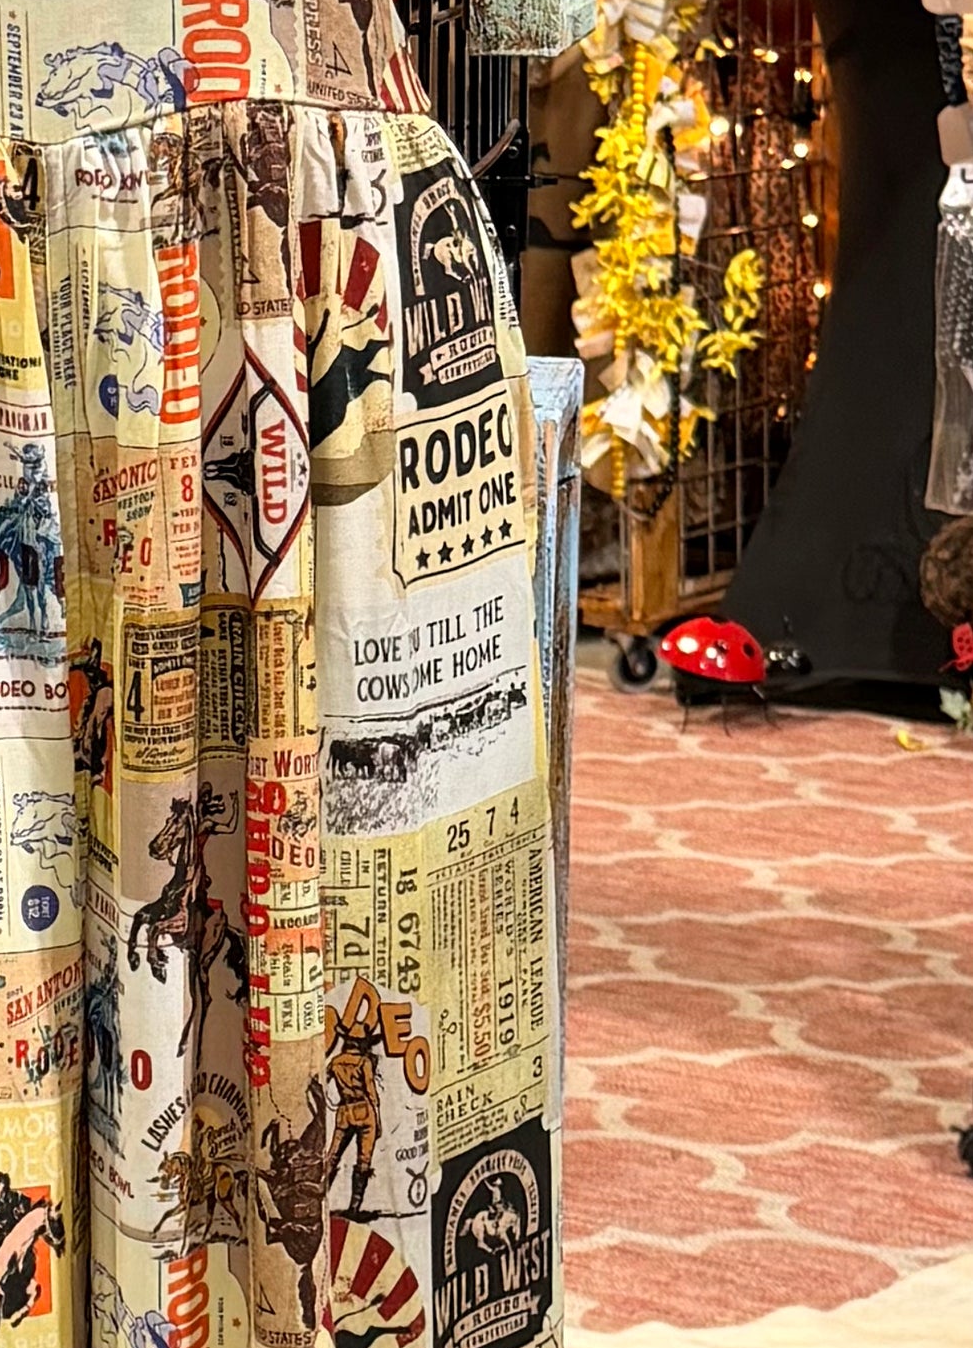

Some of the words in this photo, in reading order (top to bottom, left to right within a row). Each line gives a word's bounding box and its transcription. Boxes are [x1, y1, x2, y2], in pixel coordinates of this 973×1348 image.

[7, 23, 23, 100] SEPTEMBER
[9, 101, 23, 120] 23
[154, 243, 202, 425] RODEO
[403, 292, 465, 356] WILD
[260, 419, 287, 525] WILD
[400, 402, 513, 494] RODEO
[180, 473, 193, 502] 8
[408, 484, 474, 539] ADMIT
[478, 470, 516, 515] ONE
[354, 635, 402, 666] LOVE
[427, 614, 466, 648] TILL
[473, 595, 504, 631] THE
[452, 633, 502, 679] HOME
[127, 671, 145, 723] 4
[447, 820, 470, 852] 25
[486, 806, 497, 836] 7
[510, 796, 519, 824] 4
[528, 848, 544, 944] AMERICAN
[396, 911, 422, 996] 6743
[6, 998, 33, 1026] SAN
[498, 976, 516, 1047] 1919
[530, 954, 545, 1033] LEAGUE
[141, 1096, 186, 1152] LASHES
[435, 1084, 476, 1113] RAIN
[435, 1091, 494, 1128] CHECK
[434, 1263, 490, 1339] WILD
[500, 1229, 551, 1293] WEST
